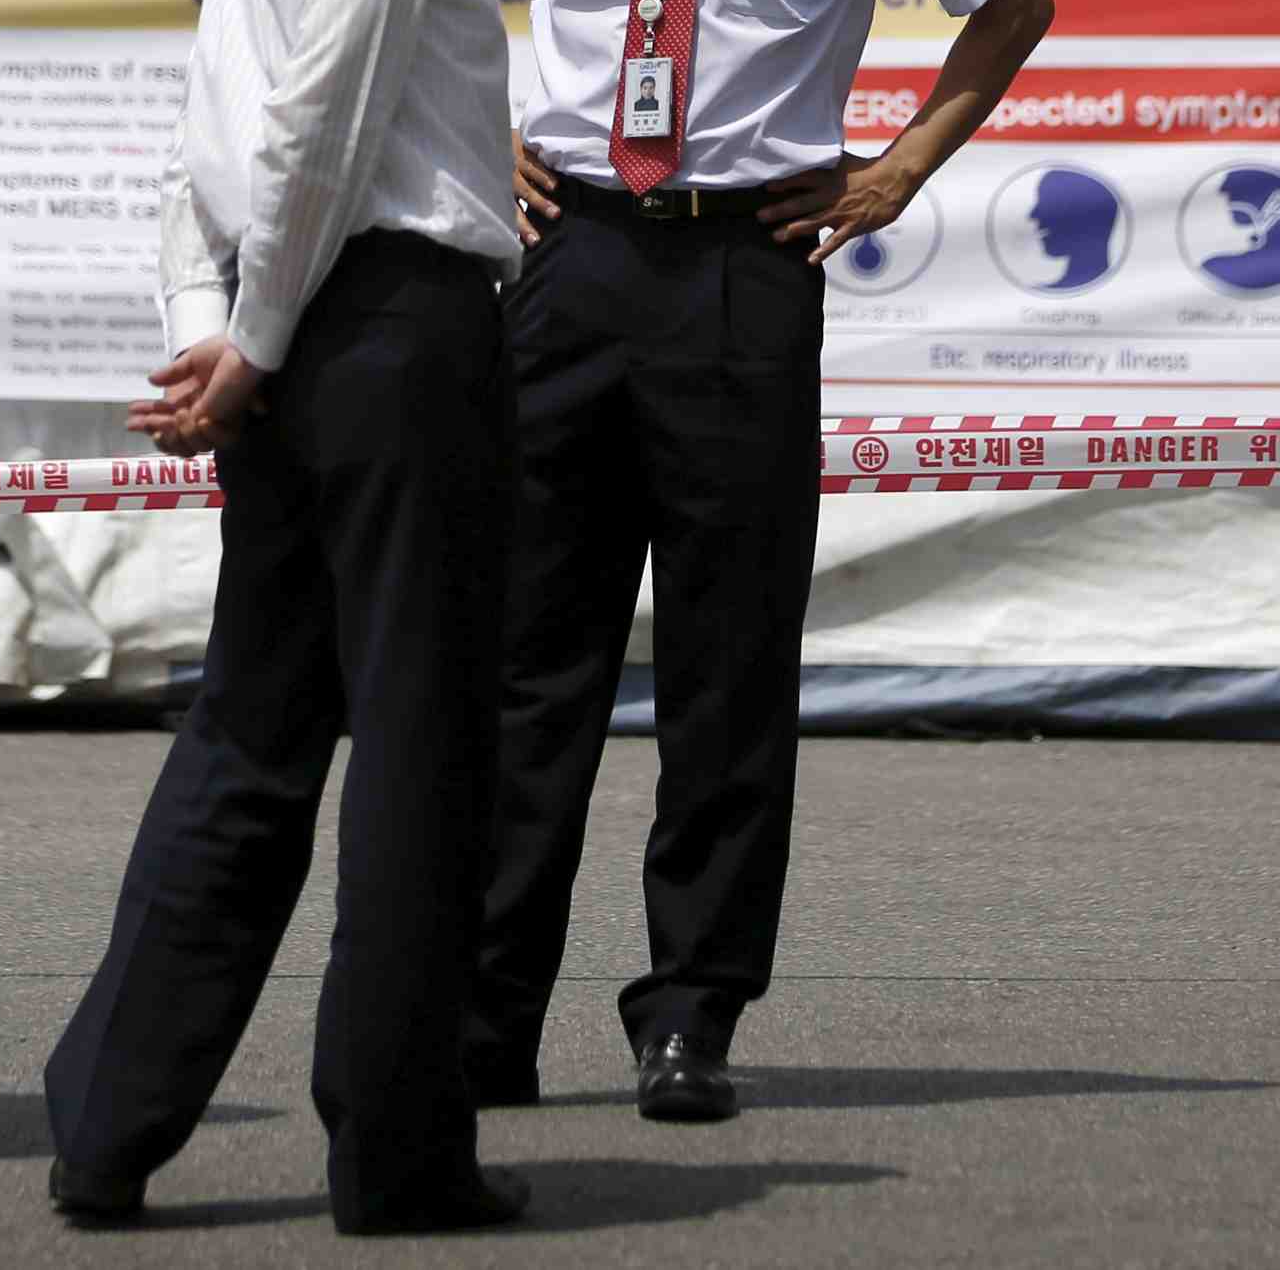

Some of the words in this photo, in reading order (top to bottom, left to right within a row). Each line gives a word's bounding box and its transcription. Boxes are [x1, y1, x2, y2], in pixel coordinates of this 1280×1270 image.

[915, 436, 1046, 469] 안전제일
[1086, 434, 1220, 464] DANGER
[111, 456, 217, 487] DANGE
